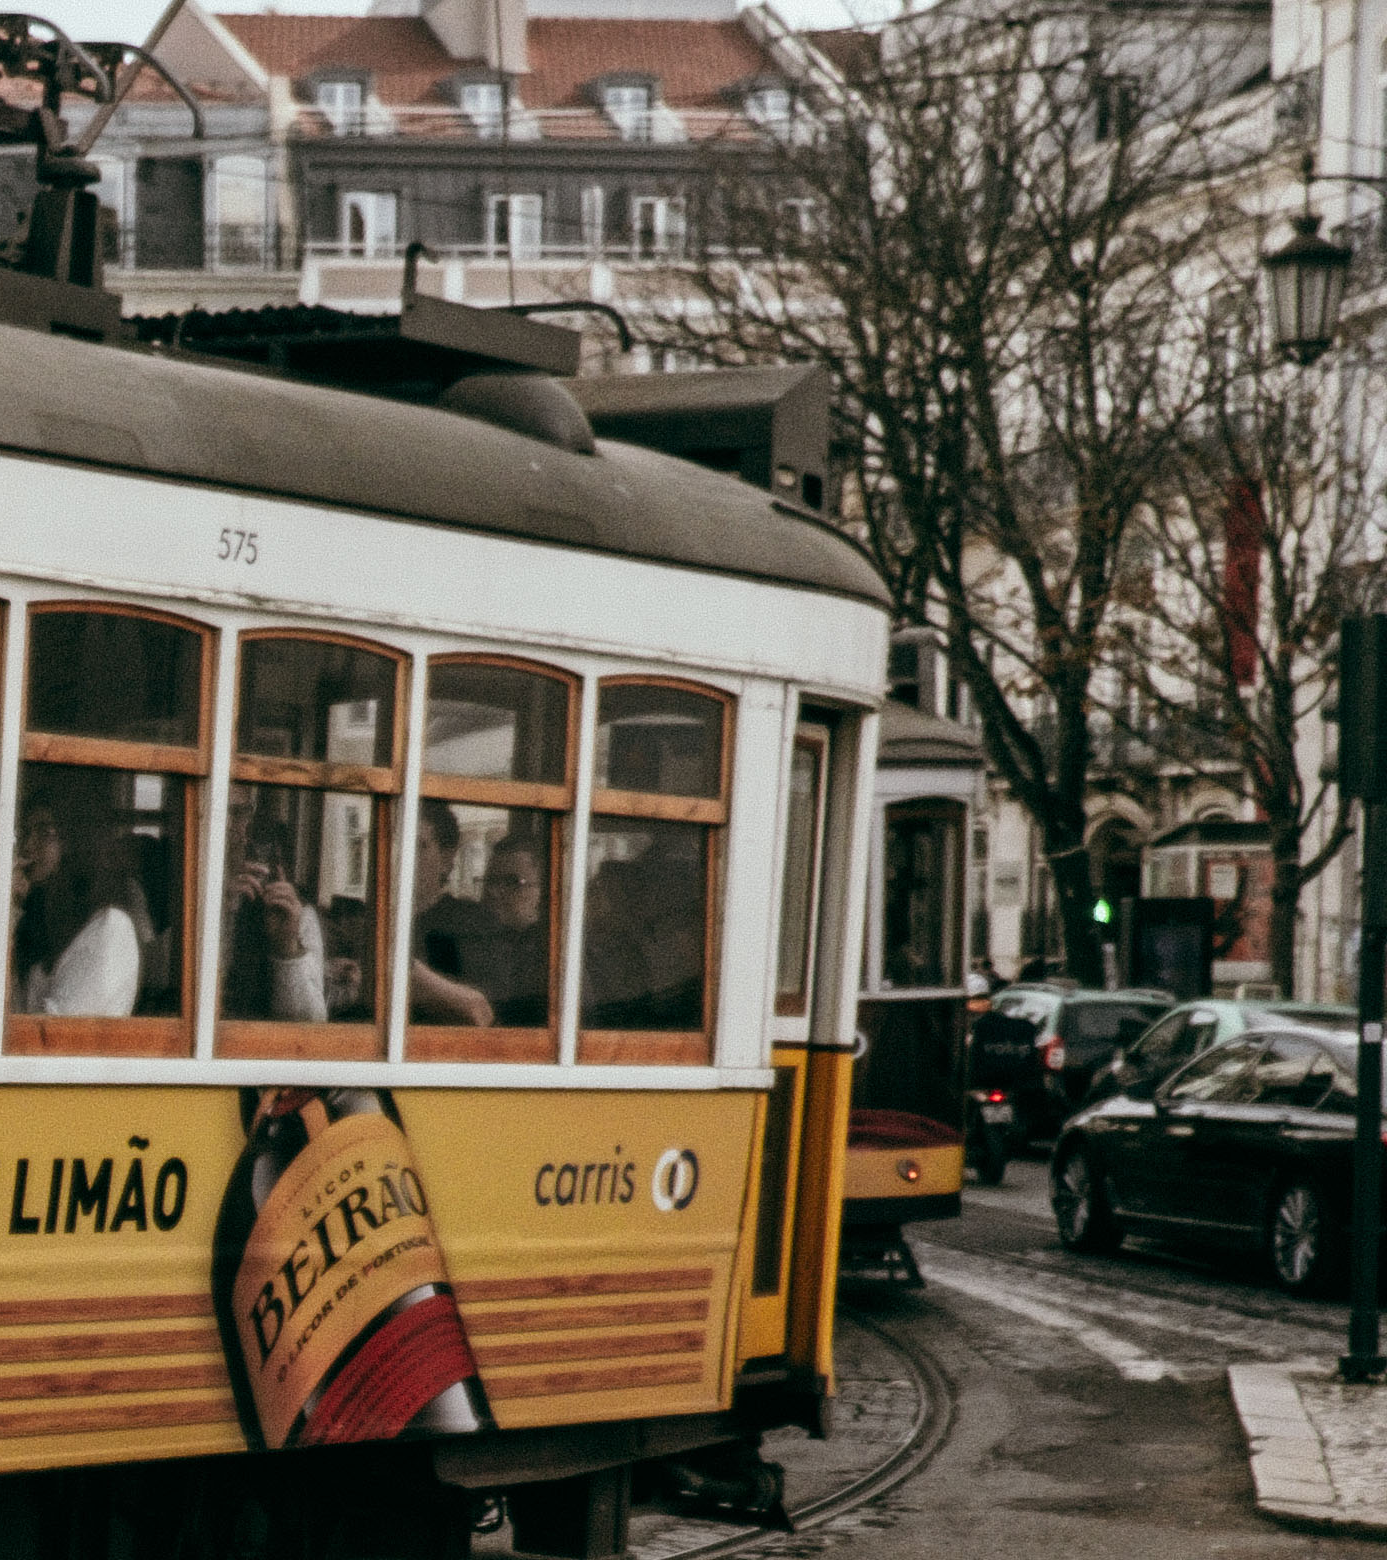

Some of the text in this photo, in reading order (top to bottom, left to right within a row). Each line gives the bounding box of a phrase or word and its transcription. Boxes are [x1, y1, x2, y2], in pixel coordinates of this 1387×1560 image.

[218, 527, 258, 565] 575
[8, 1135, 189, 1236] LIMÃO
[300, 1159, 366, 1220] LICOR
[534, 1143, 635, 1207] carris
[249, 1160, 428, 1373] BEIRÃO
[335, 1273, 359, 1302] DE
